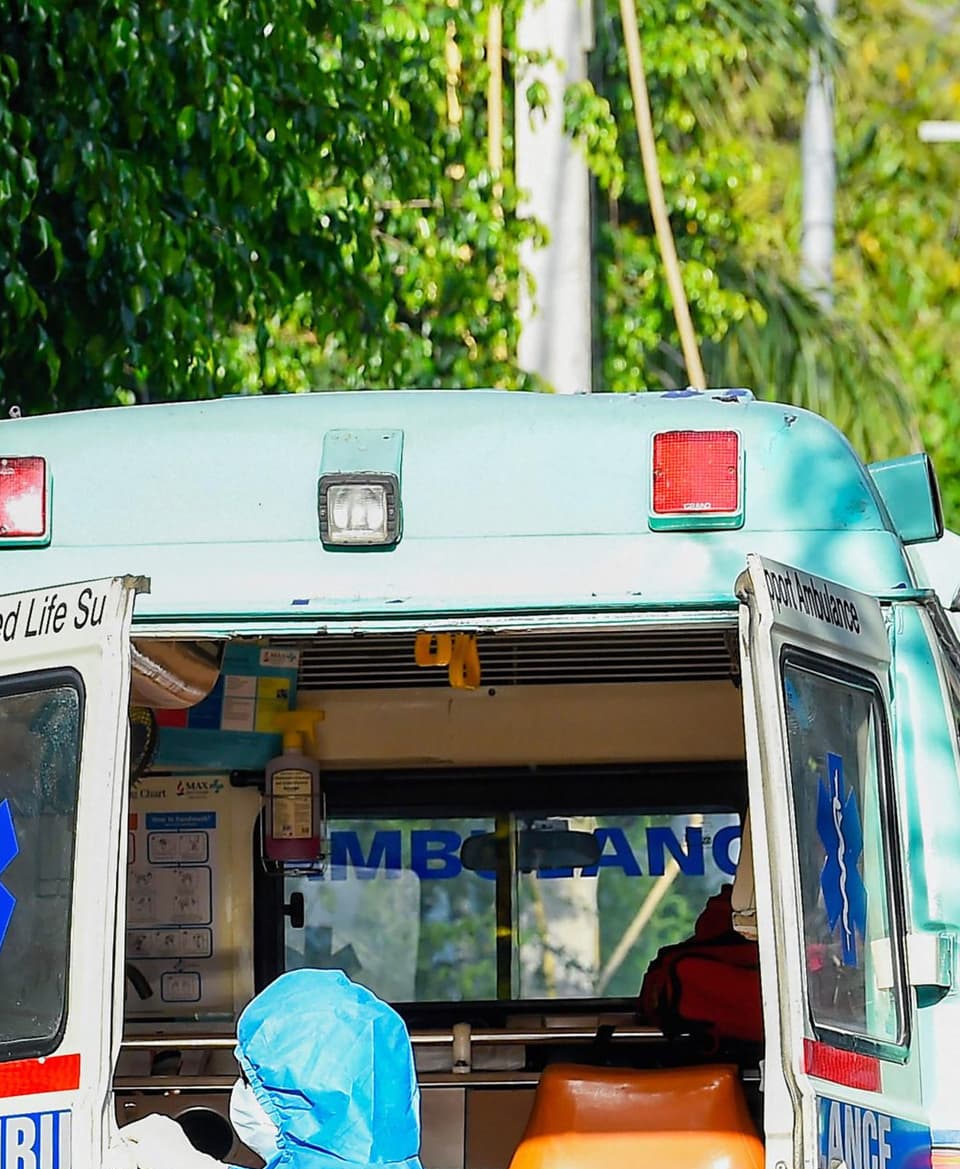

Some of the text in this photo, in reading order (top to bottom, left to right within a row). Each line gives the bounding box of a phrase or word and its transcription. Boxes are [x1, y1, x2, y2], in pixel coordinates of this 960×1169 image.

[24, 594, 67, 637] Life
[74, 587, 107, 629] Su
[794, 572, 860, 634] Ambulance
